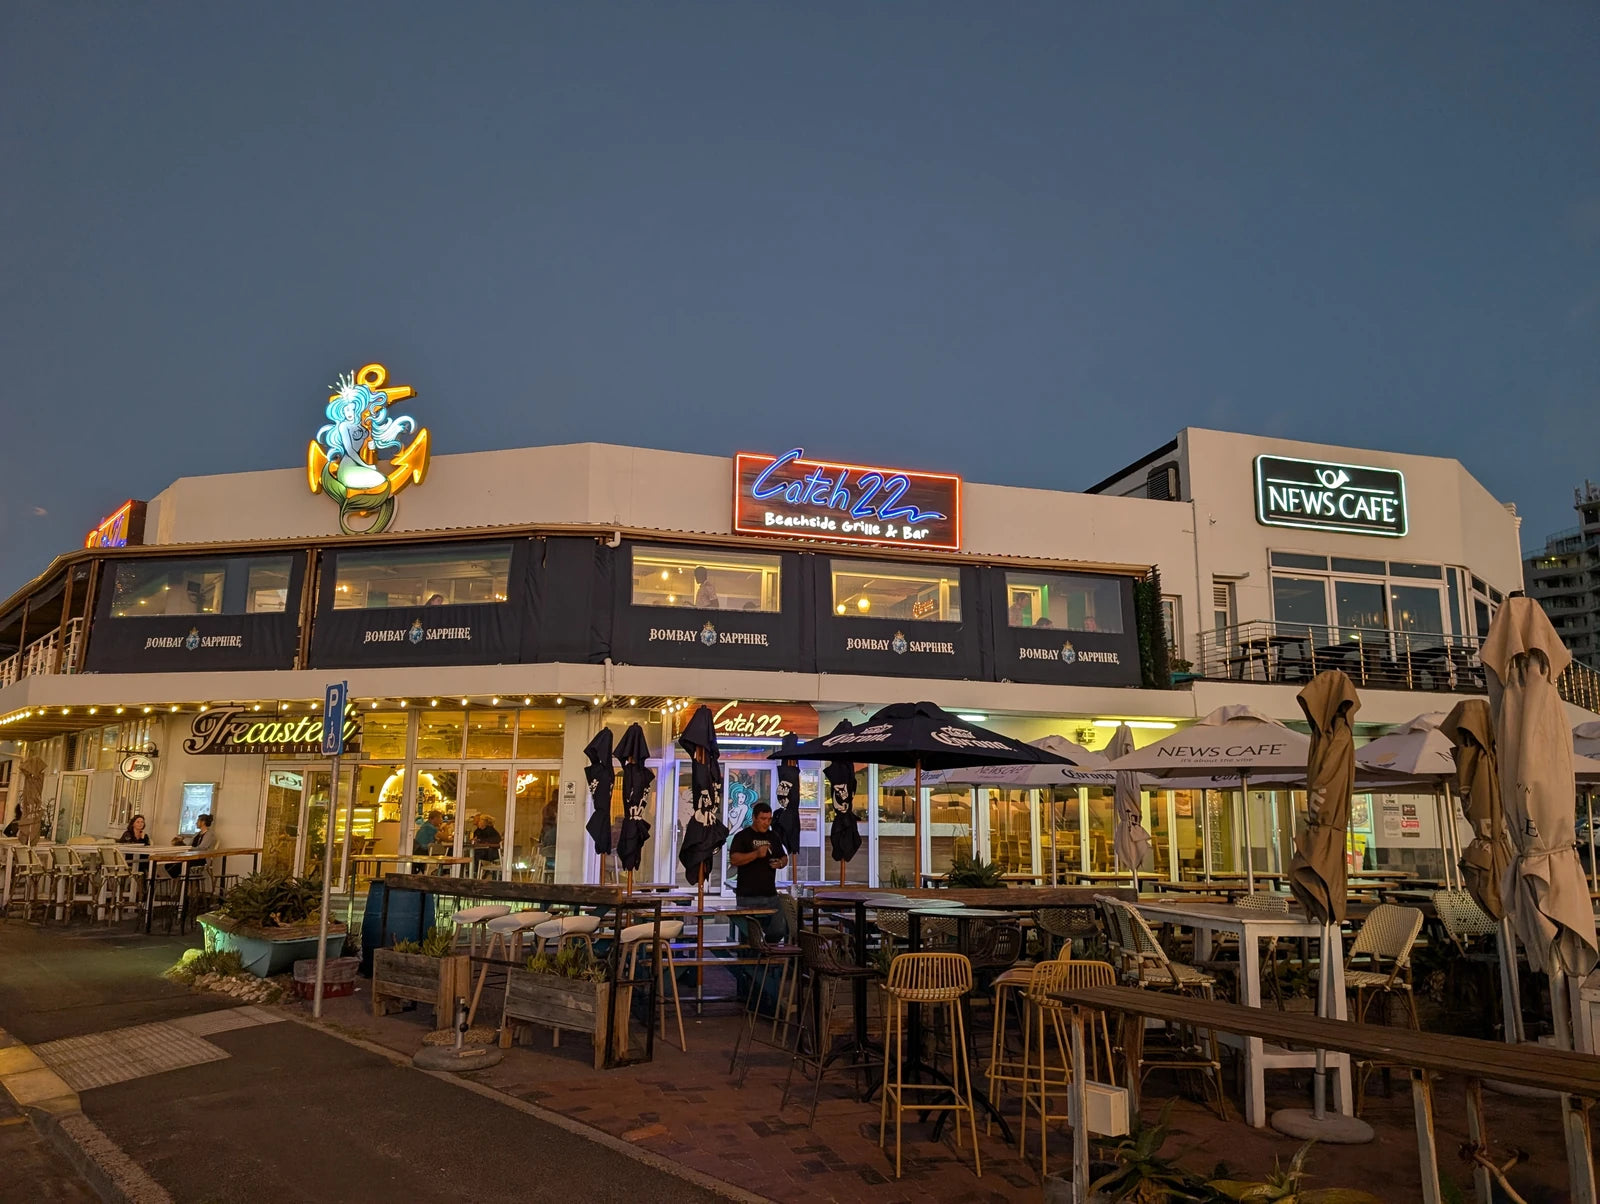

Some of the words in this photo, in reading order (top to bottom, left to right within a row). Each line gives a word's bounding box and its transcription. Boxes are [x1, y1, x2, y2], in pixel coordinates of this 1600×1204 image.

[752, 448, 851, 511] Catch
[850, 471, 947, 525] 22
[1268, 486, 1336, 516] NEWS
[764, 511, 837, 531] Beachside
[841, 521, 881, 536] Grille
[885, 524, 898, 538] &
[902, 527, 930, 540] Bar
[144, 637, 184, 650] BOMBAY
[200, 635, 242, 648] SAPPHIRE
[363, 629, 407, 644] BOMBAY
[425, 627, 472, 641] SAPPHIRE
[648, 628, 698, 642] BOMBAY
[719, 632, 769, 647] SAPPHIRE
[846, 637, 890, 651] BOMBAY
[909, 640, 955, 655] SAPPHIRE
[1019, 647, 1060, 660] BOMBAY
[1078, 650, 1120, 665] SAPPHIRE
[328, 688, 339, 718] P
[713, 700, 755, 733] Catch
[753, 714, 796, 737] 22
[183, 703, 359, 754] Trecastei
[214, 745, 285, 753] TRADIZIONE
[292, 745, 350, 753] ITALA
[822, 733, 892, 747] Corona
[930, 731, 1013, 750] Corona
[1157, 746, 1220, 757] NEWS
[1225, 744, 1283, 756] CAFE
[1061, 769, 1115, 780] Corona
